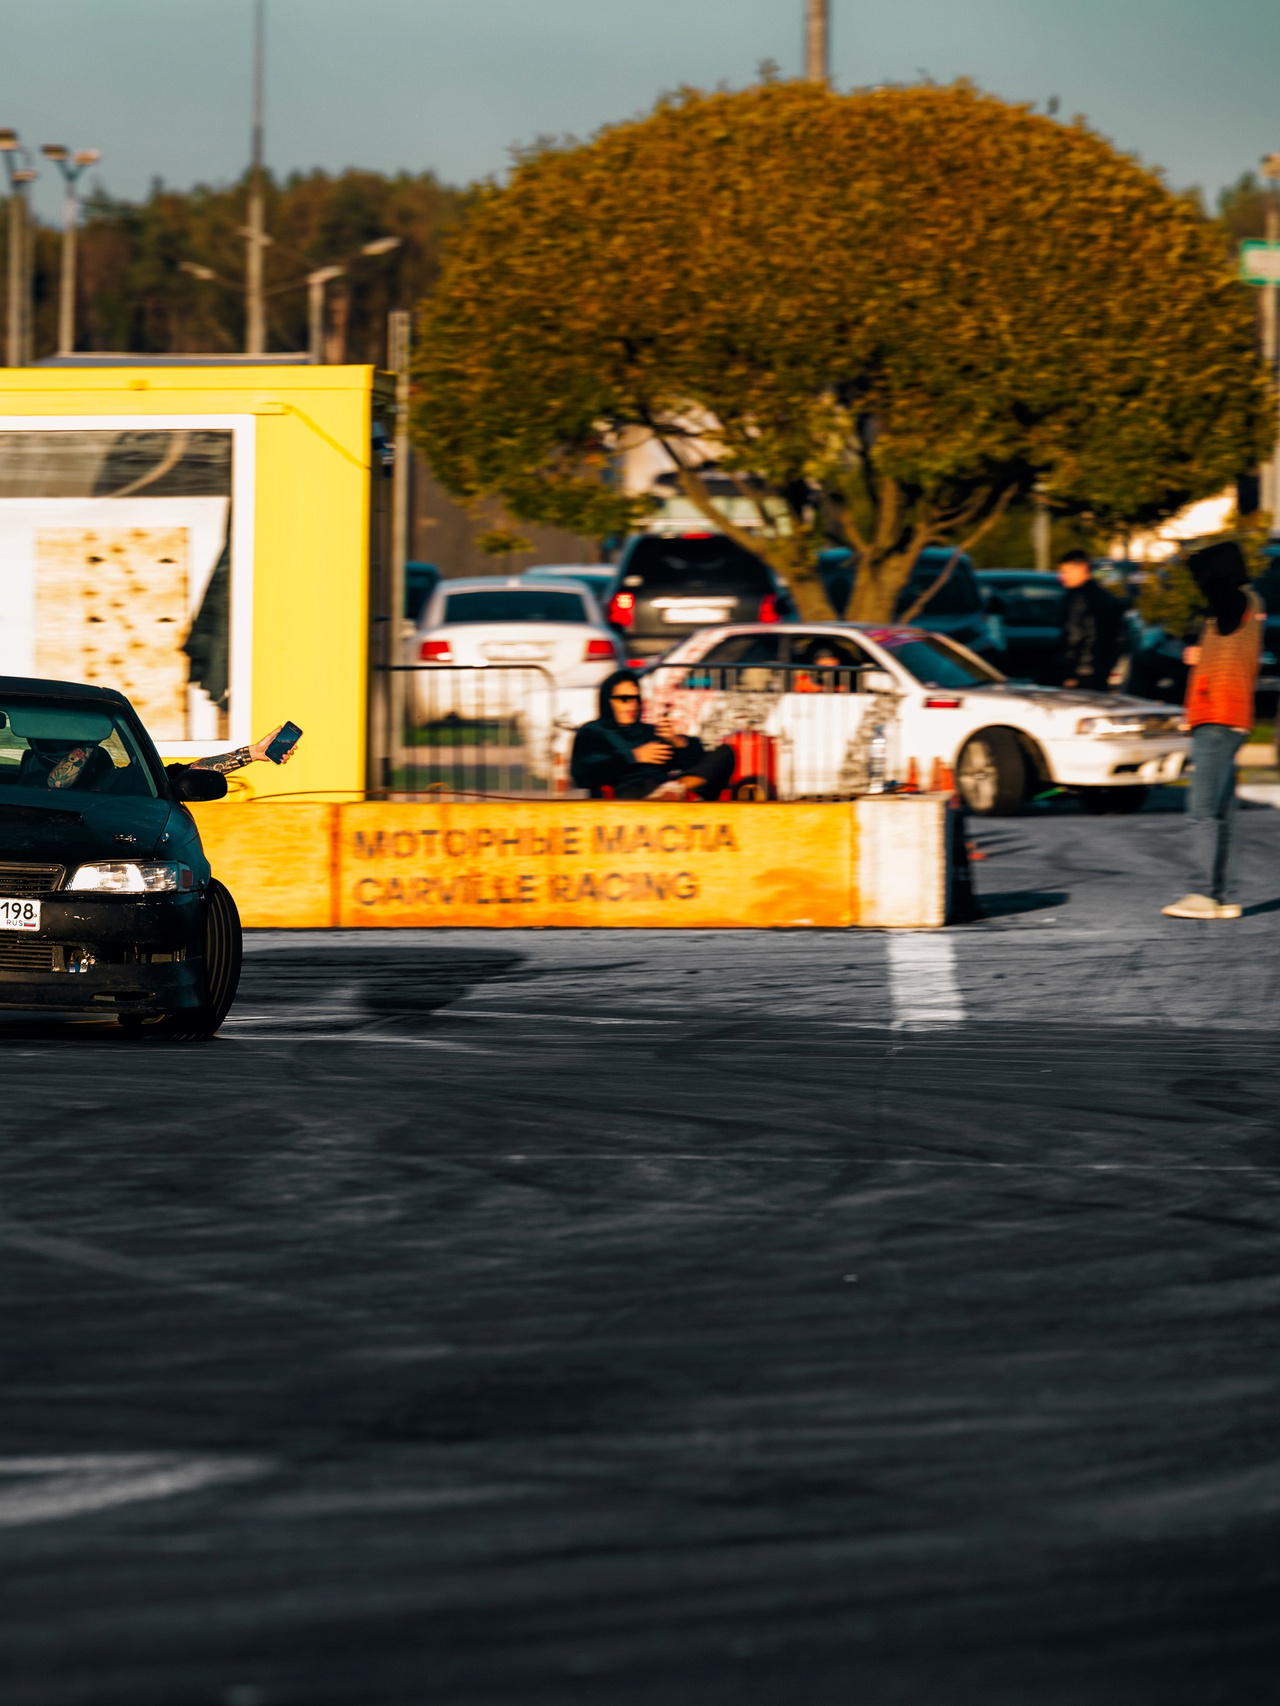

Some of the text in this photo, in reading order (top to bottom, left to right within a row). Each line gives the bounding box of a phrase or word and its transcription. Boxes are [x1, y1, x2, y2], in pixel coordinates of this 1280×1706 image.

[354, 824, 740, 859] МОТОРНЫЕ МАСЛА
[353, 871, 701, 906] CARVILLE RACING
[0, 902, 34, 920] 198
[6, 919, 23, 927] RUS
